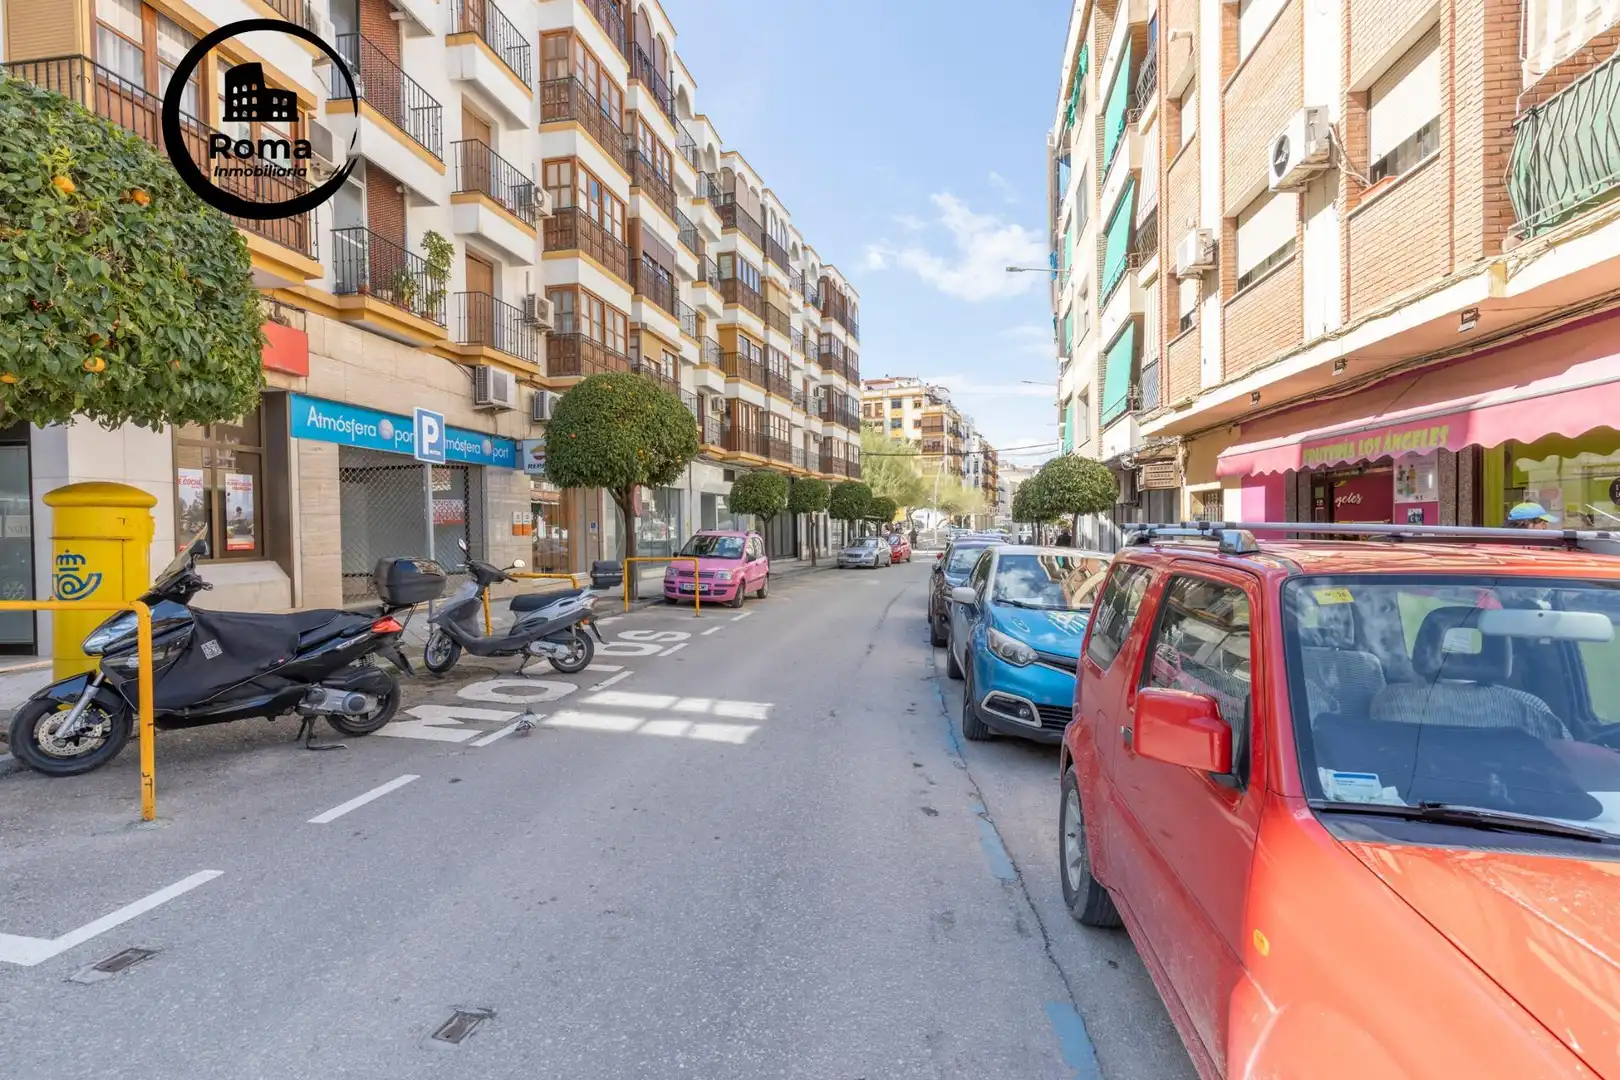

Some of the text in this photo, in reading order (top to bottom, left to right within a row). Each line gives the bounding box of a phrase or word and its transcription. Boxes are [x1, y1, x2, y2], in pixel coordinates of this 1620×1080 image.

[306, 405, 377, 442] Atmósfera
[421, 415, 440, 455] P
[445, 438, 480, 459] mósfera
[1358, 436, 1383, 457] LOS
[1384, 426, 1449, 452] ÁNGELES
